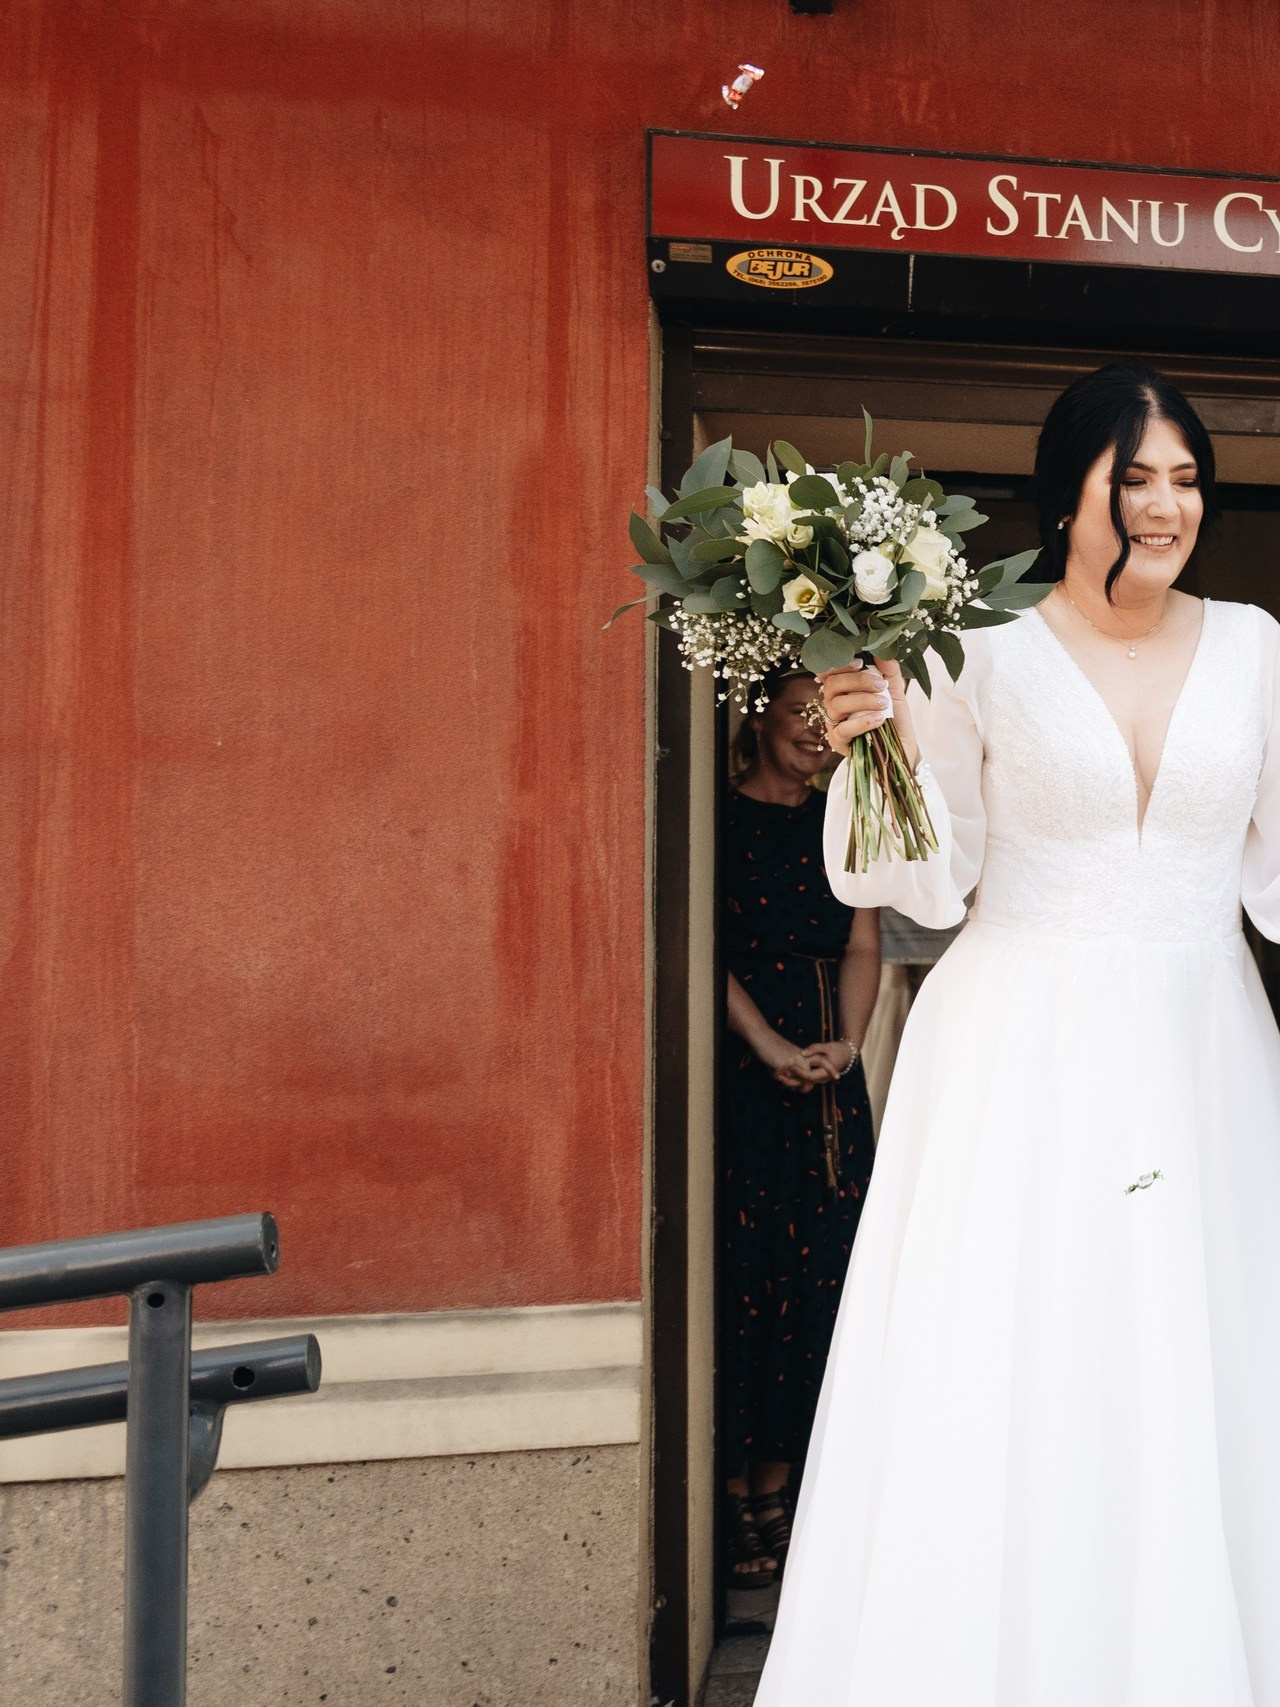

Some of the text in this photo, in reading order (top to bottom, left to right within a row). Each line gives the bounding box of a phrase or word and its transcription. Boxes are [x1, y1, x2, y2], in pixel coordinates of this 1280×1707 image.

[723, 155, 957, 240] URZĄD
[986, 174, 1188, 247] STANU
[748, 250, 812, 263] OCHRONA
[733, 269, 747, 281] TEL.
[748, 259, 812, 281] BEJUR
